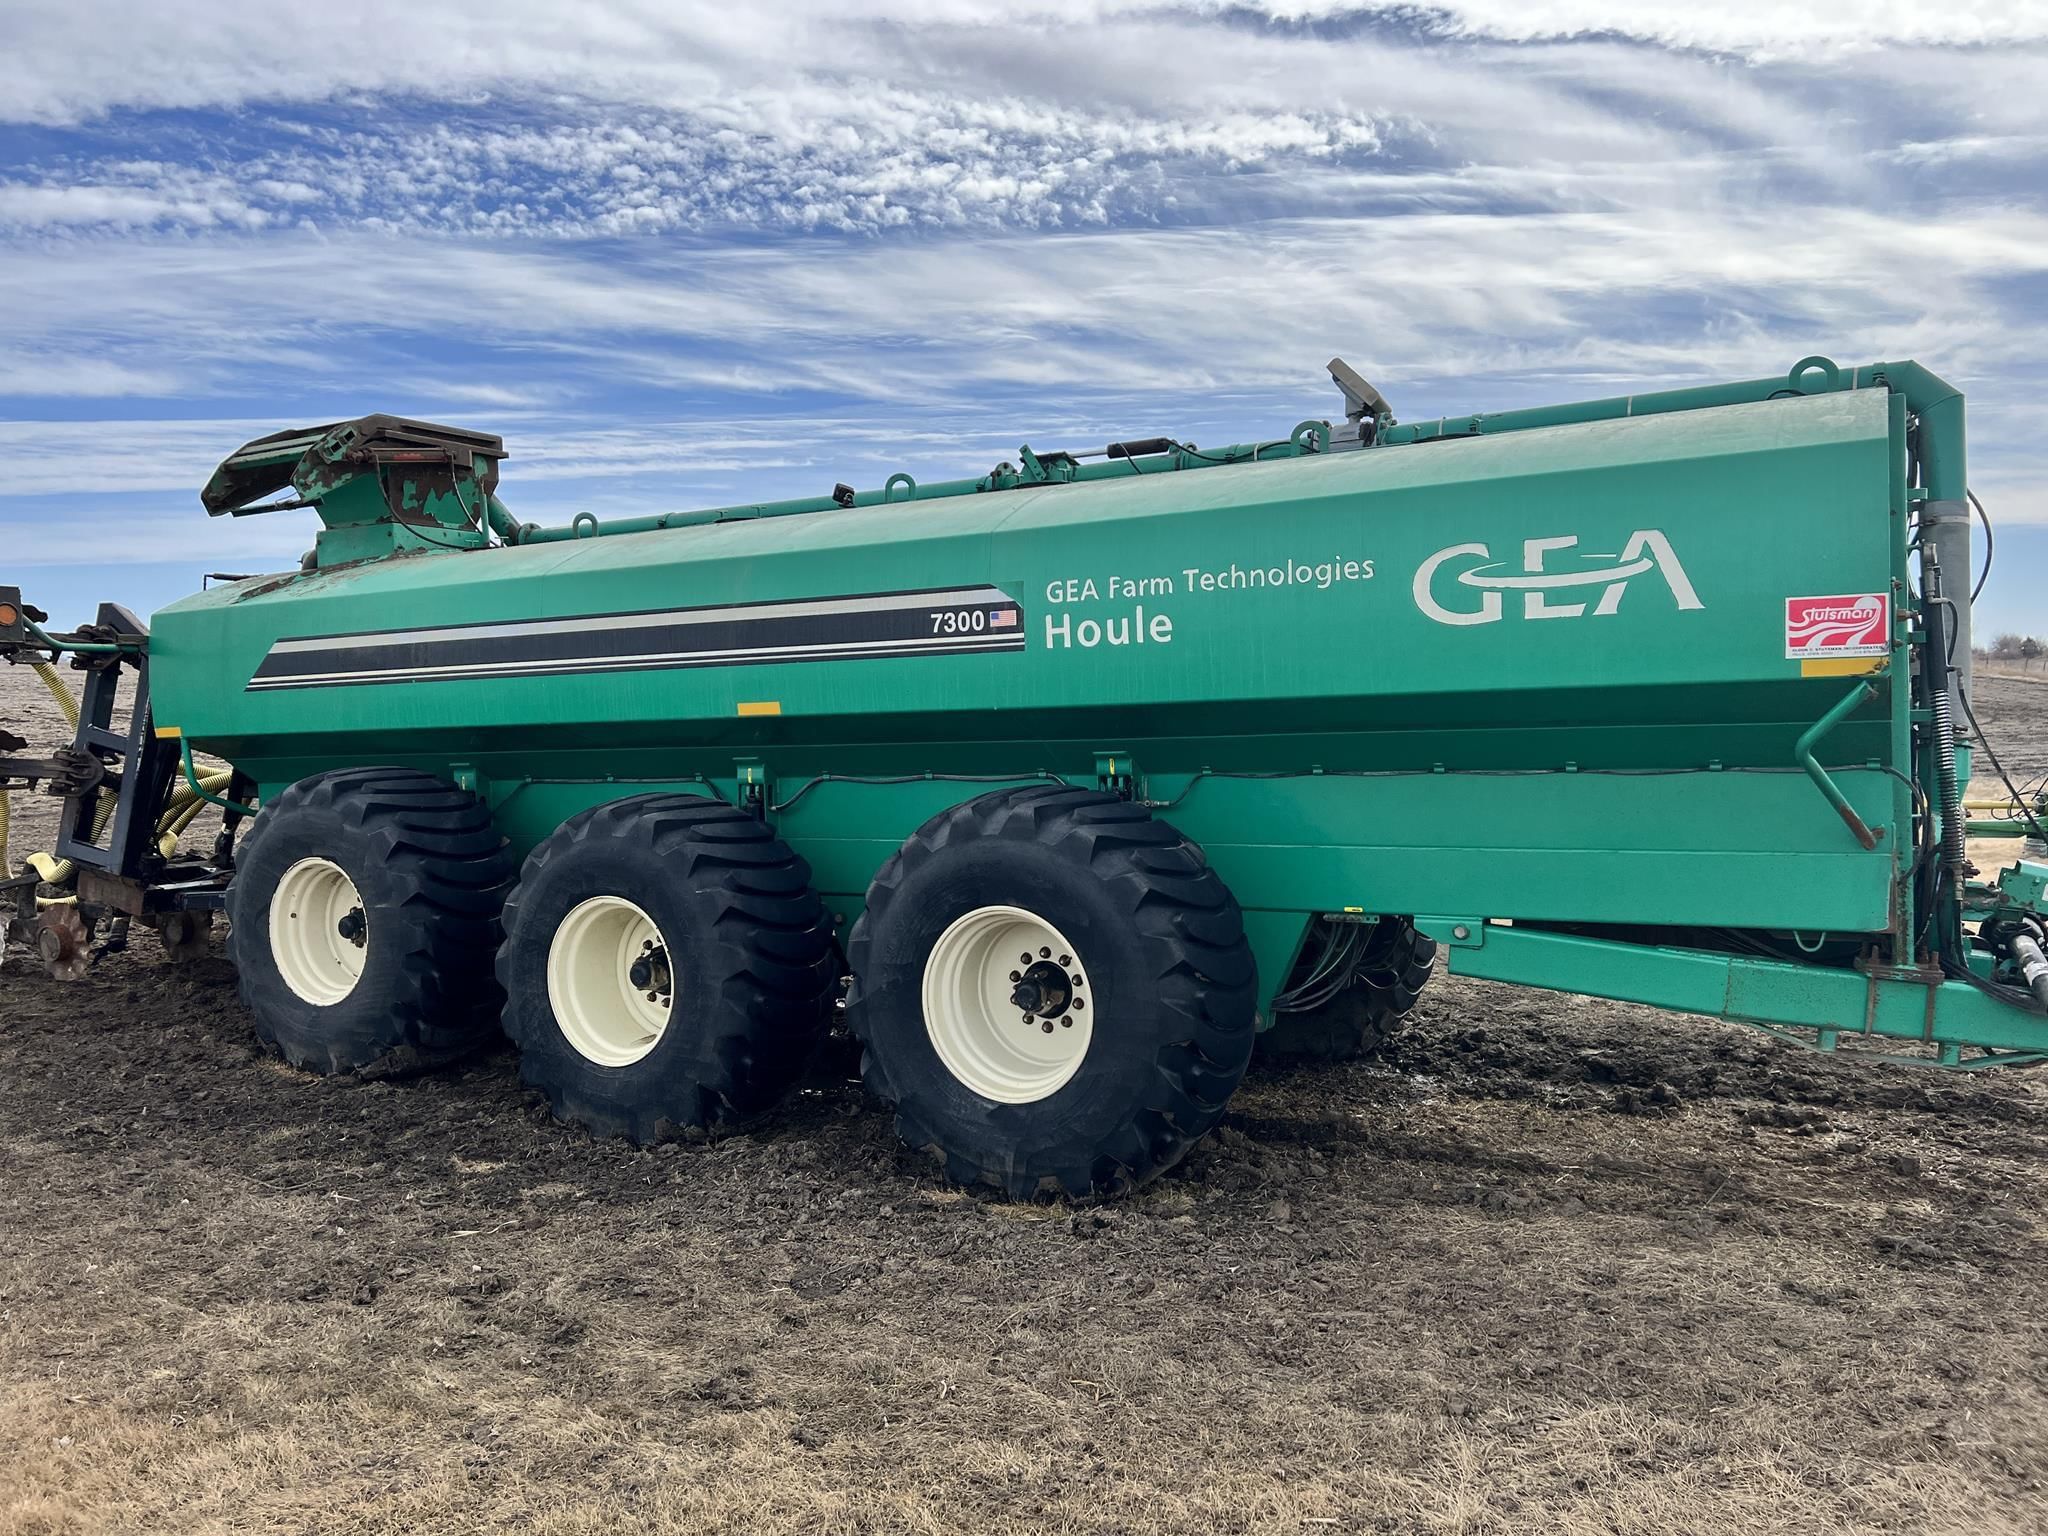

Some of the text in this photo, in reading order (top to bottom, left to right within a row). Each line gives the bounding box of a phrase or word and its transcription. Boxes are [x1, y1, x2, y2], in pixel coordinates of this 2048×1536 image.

[1046, 556, 1375, 604] GEA Farm Technologies
[1412, 529, 1705, 626] GEA
[930, 610, 985, 633] 7300
[1045, 605, 1173, 649] Houle
[1802, 607, 1873, 627] Stutsman
